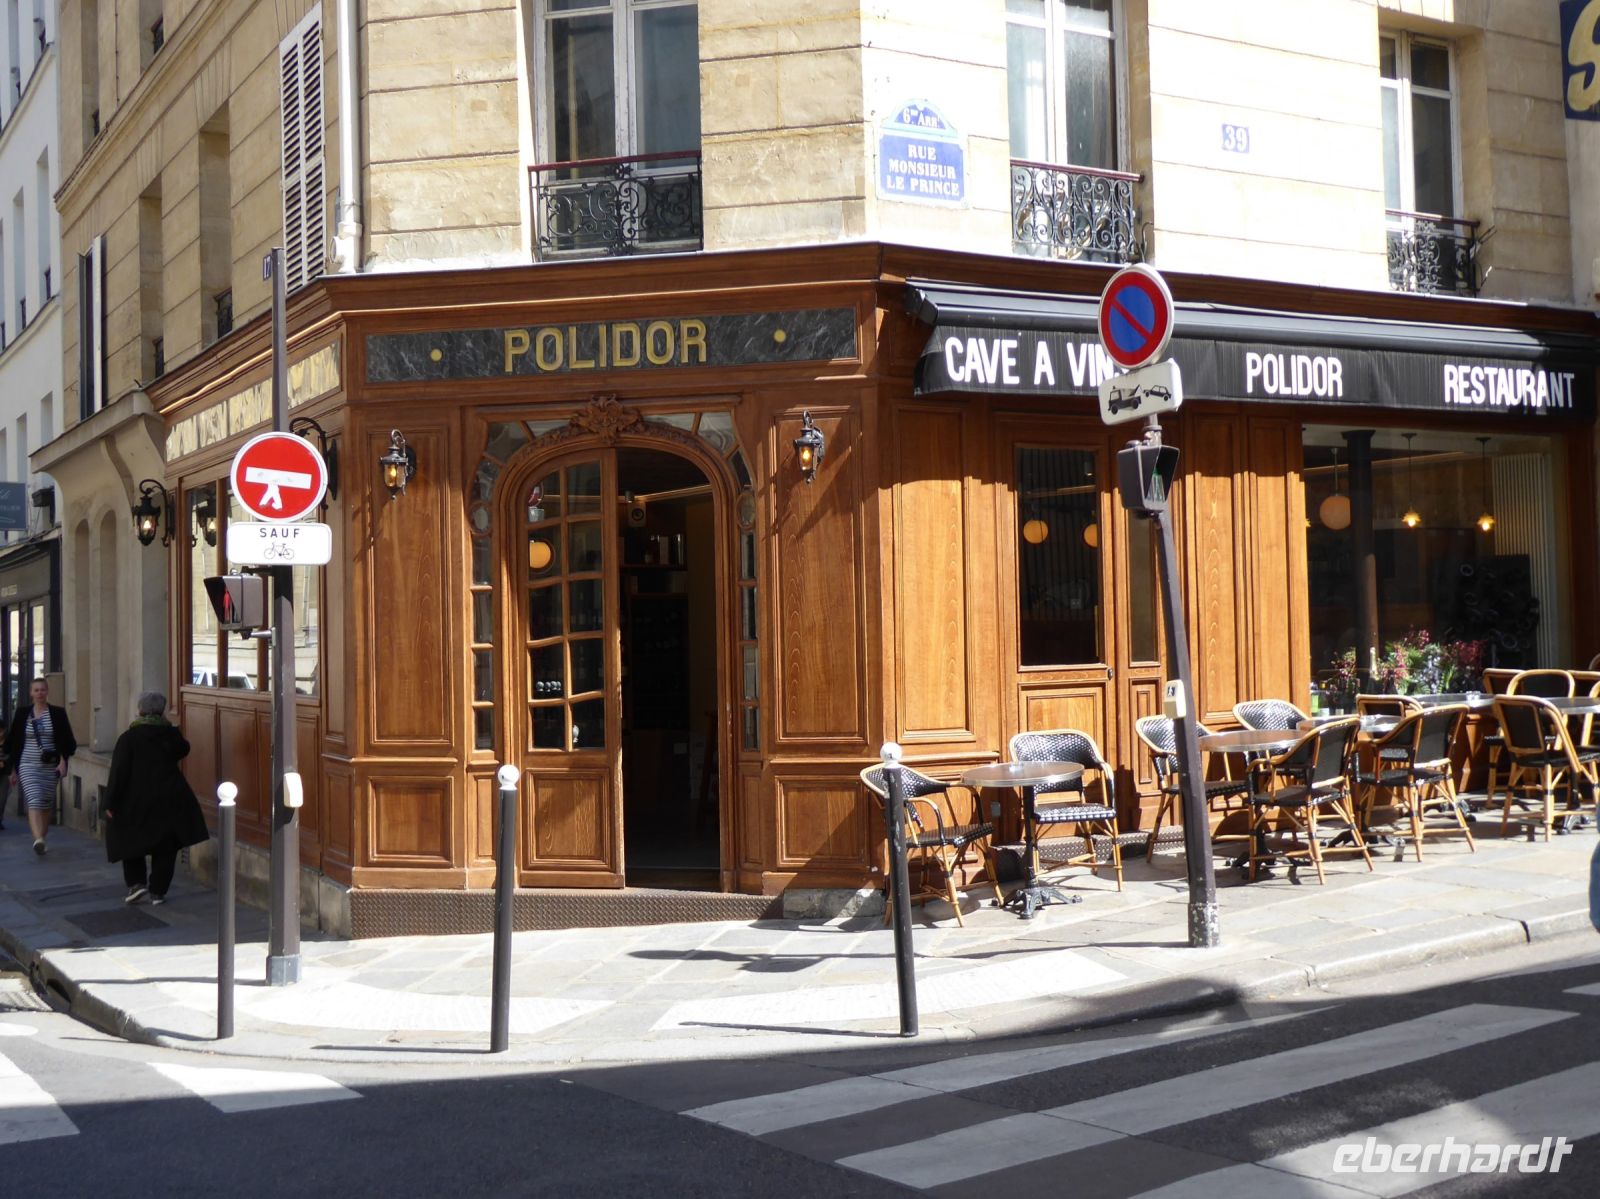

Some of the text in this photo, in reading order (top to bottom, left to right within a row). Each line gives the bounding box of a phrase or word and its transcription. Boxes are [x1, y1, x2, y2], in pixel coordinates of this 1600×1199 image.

[908, 143, 937, 161] RUE
[1224, 125, 1247, 152] 39
[888, 158, 956, 180] MONSIEUR
[886, 174, 960, 197] LE PRINCE
[504, 318, 707, 373] POLIDOR
[944, 336, 1130, 387] CAVE A VIN
[1246, 352, 1343, 397] POLIDOR
[1443, 364, 1575, 408] RESTAURANT
[259, 527, 301, 539] SAUF
